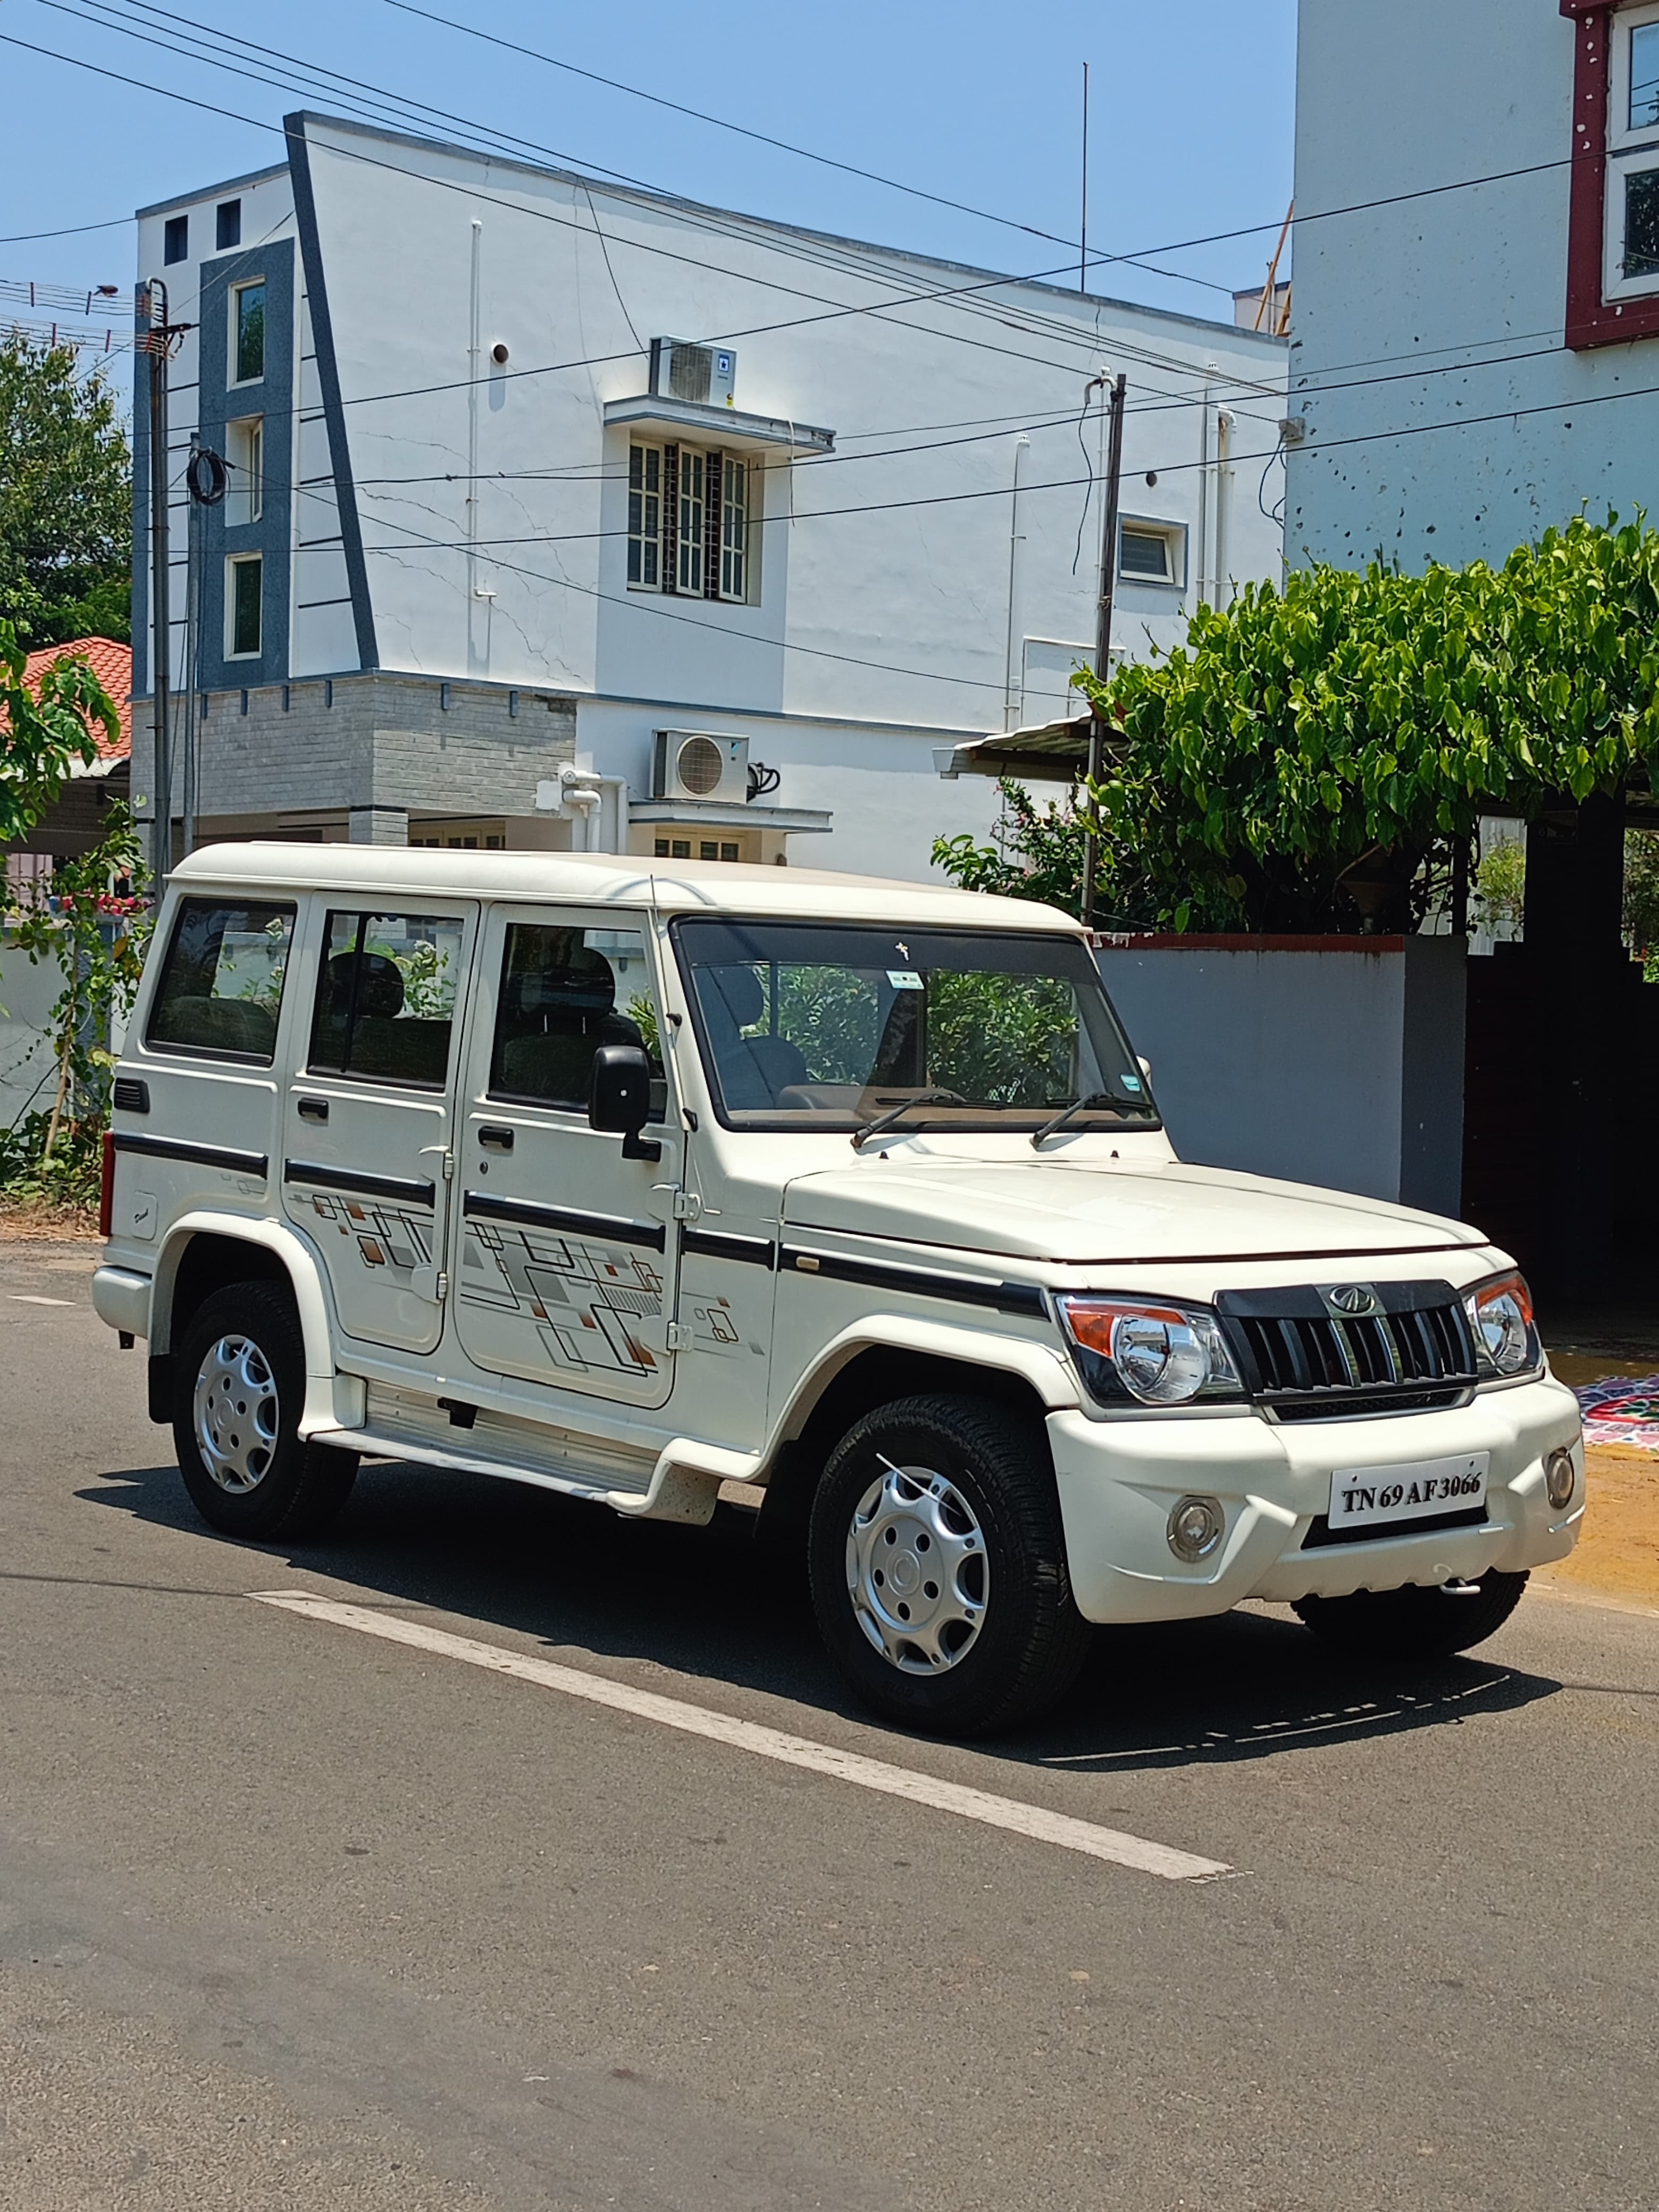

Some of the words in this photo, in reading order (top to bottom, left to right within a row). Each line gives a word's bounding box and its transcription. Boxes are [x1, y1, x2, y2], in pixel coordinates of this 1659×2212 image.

[1342, 1487, 1377, 1512] TN
[1379, 1485, 1404, 1507] 69
[1405, 1479, 1438, 1505] AF
[1438, 1472, 1482, 1499] 3066
